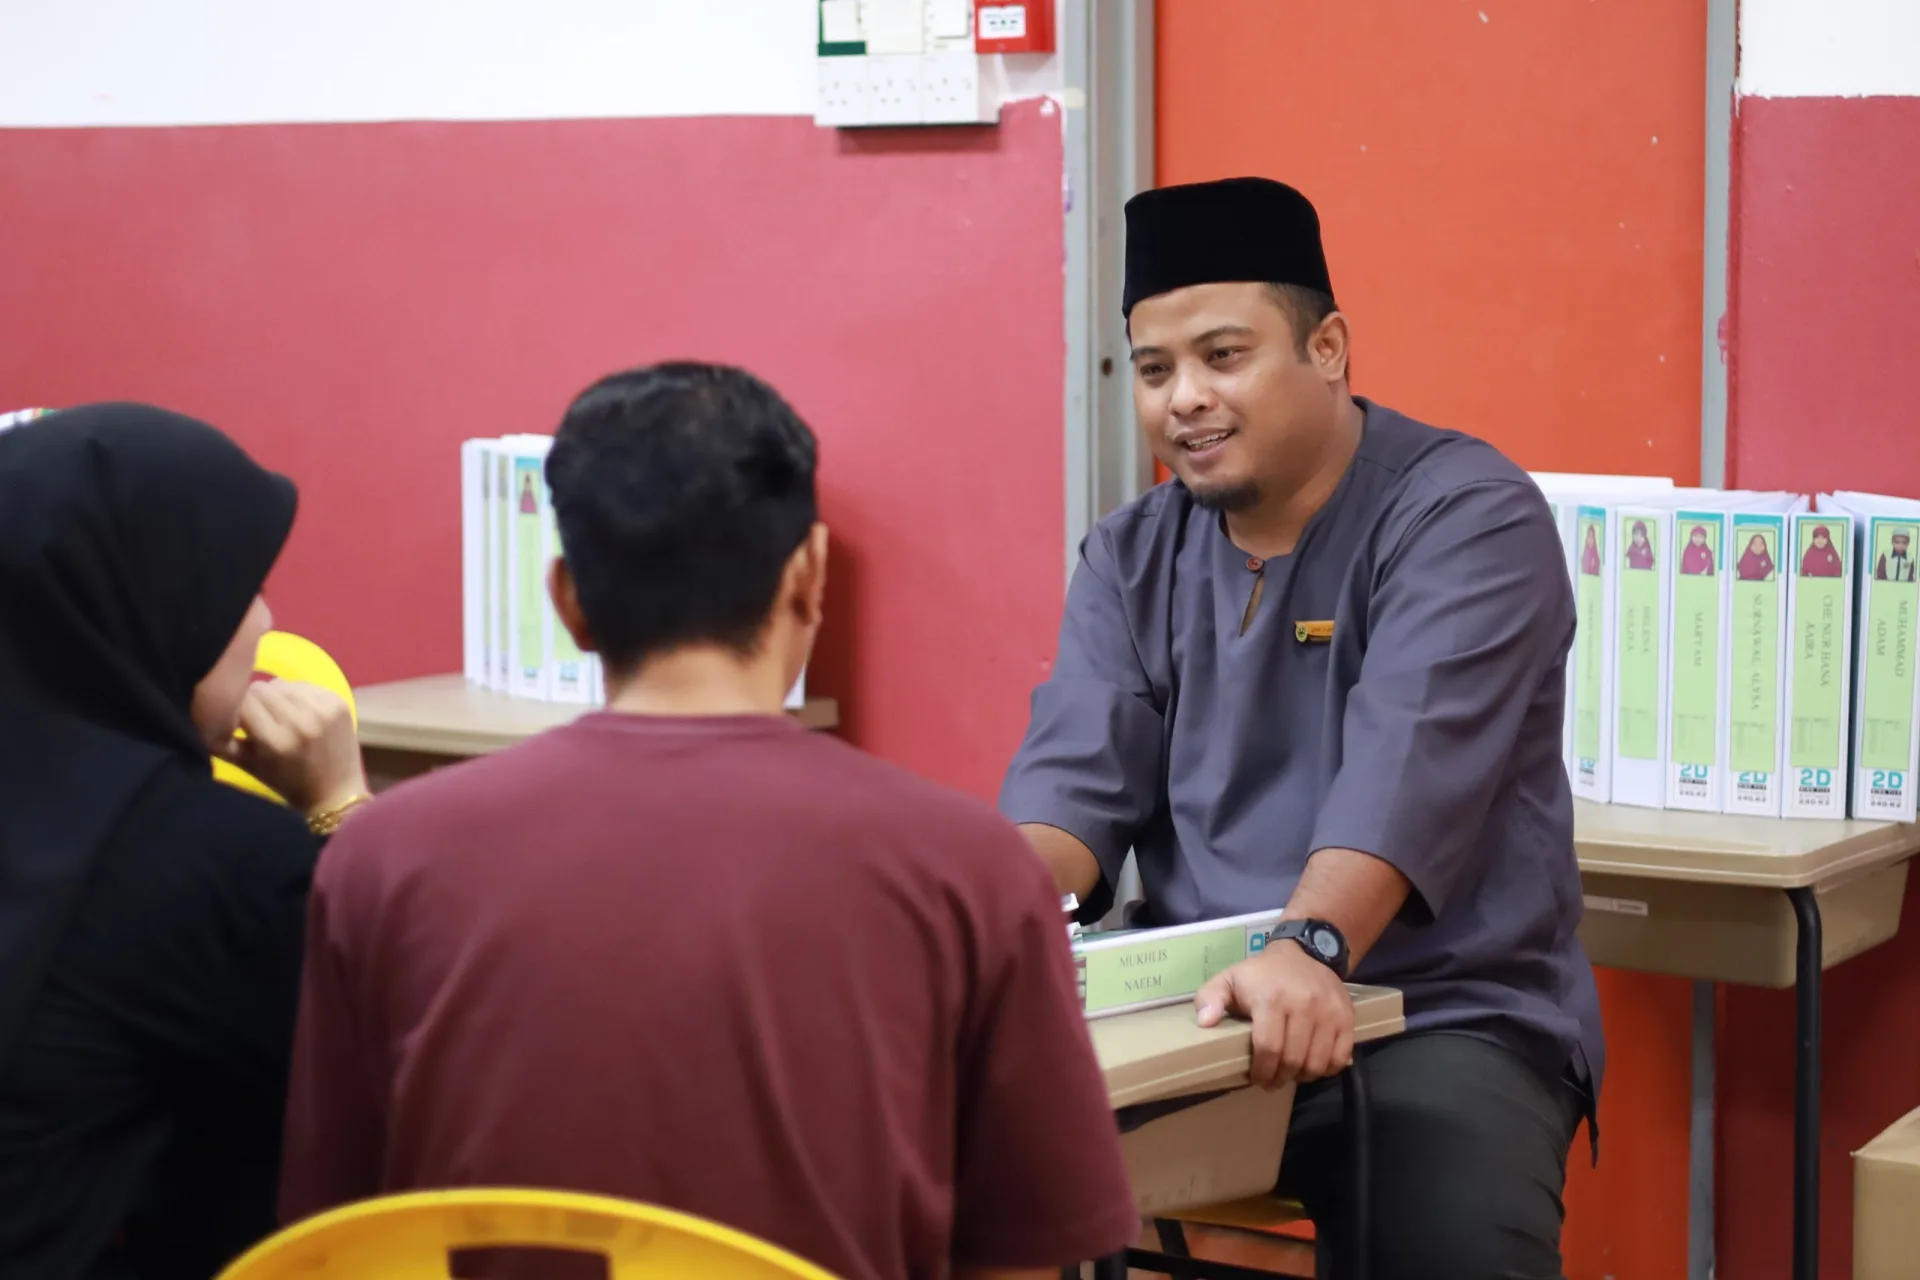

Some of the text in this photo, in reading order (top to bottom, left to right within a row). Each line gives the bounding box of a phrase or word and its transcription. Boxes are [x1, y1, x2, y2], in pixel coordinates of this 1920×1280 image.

[1820, 594, 1833, 686] CHE NUR HANA
[1876, 618, 1887, 657] ADAM
[1894, 600, 1909, 678] MUHAMMAD
[1680, 763, 1708, 778] 2D
[1800, 768, 1831, 786] 2D
[1872, 770, 1903, 789] 2D
[1119, 948, 1168, 969] MUKHLIS
[1124, 975, 1162, 992] NAEEM
